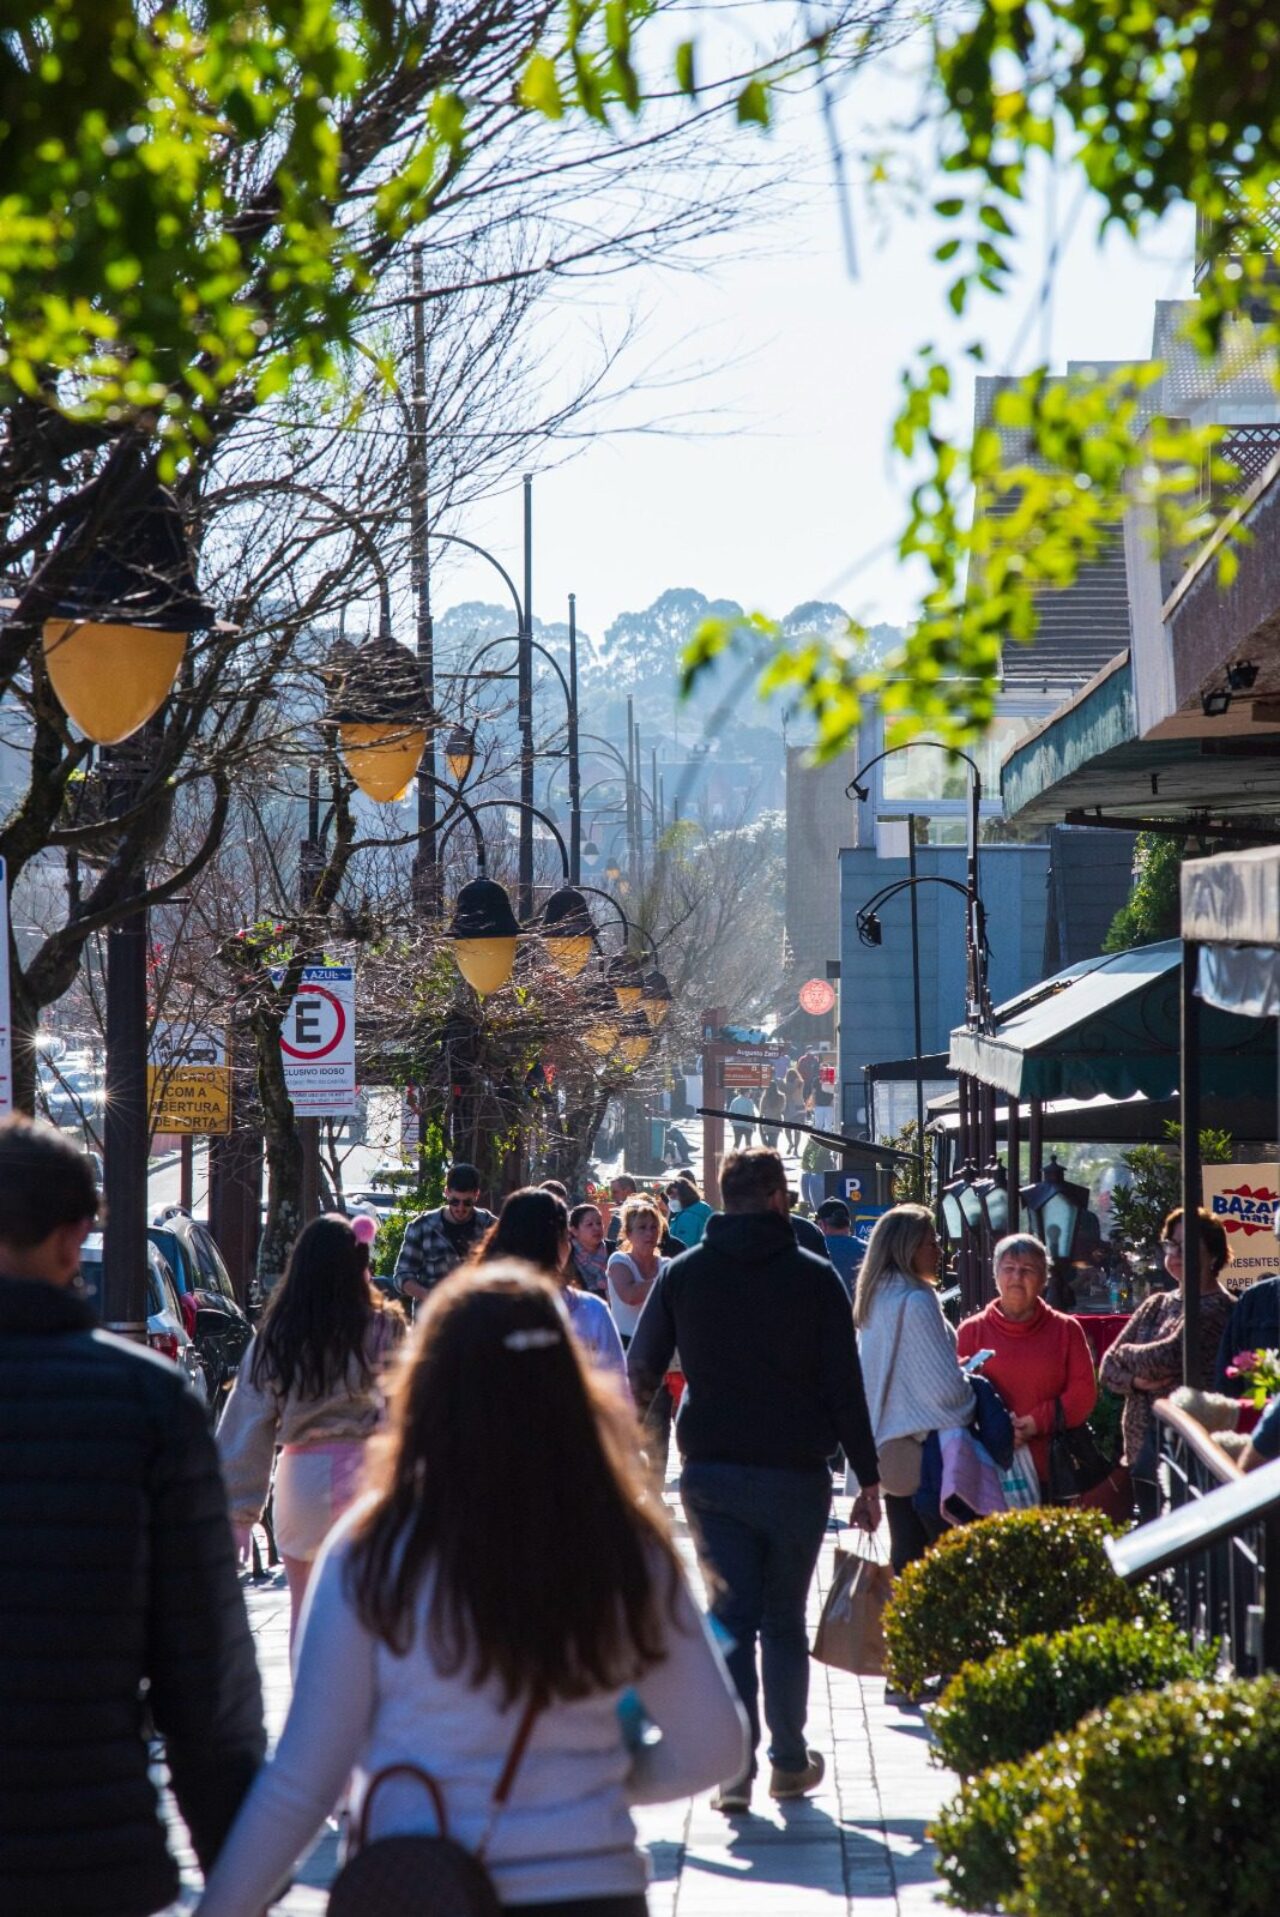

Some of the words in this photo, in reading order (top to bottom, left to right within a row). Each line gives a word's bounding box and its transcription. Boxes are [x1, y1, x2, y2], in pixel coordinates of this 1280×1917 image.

[311, 970, 338, 979] AZUL
[296, 1001, 321, 1043] E
[284, 1068, 318, 1077] CLUSIVO
[320, 1067, 345, 1075] IDOSO
[166, 1087, 194, 1098] COM
[197, 1087, 207, 1098] A
[151, 1101, 220, 1113] ABERTURA
[175, 1116, 217, 1128] PORTA
[845, 1178, 860, 1198] P
[1230, 1257, 1280, 1268] RESENTES
